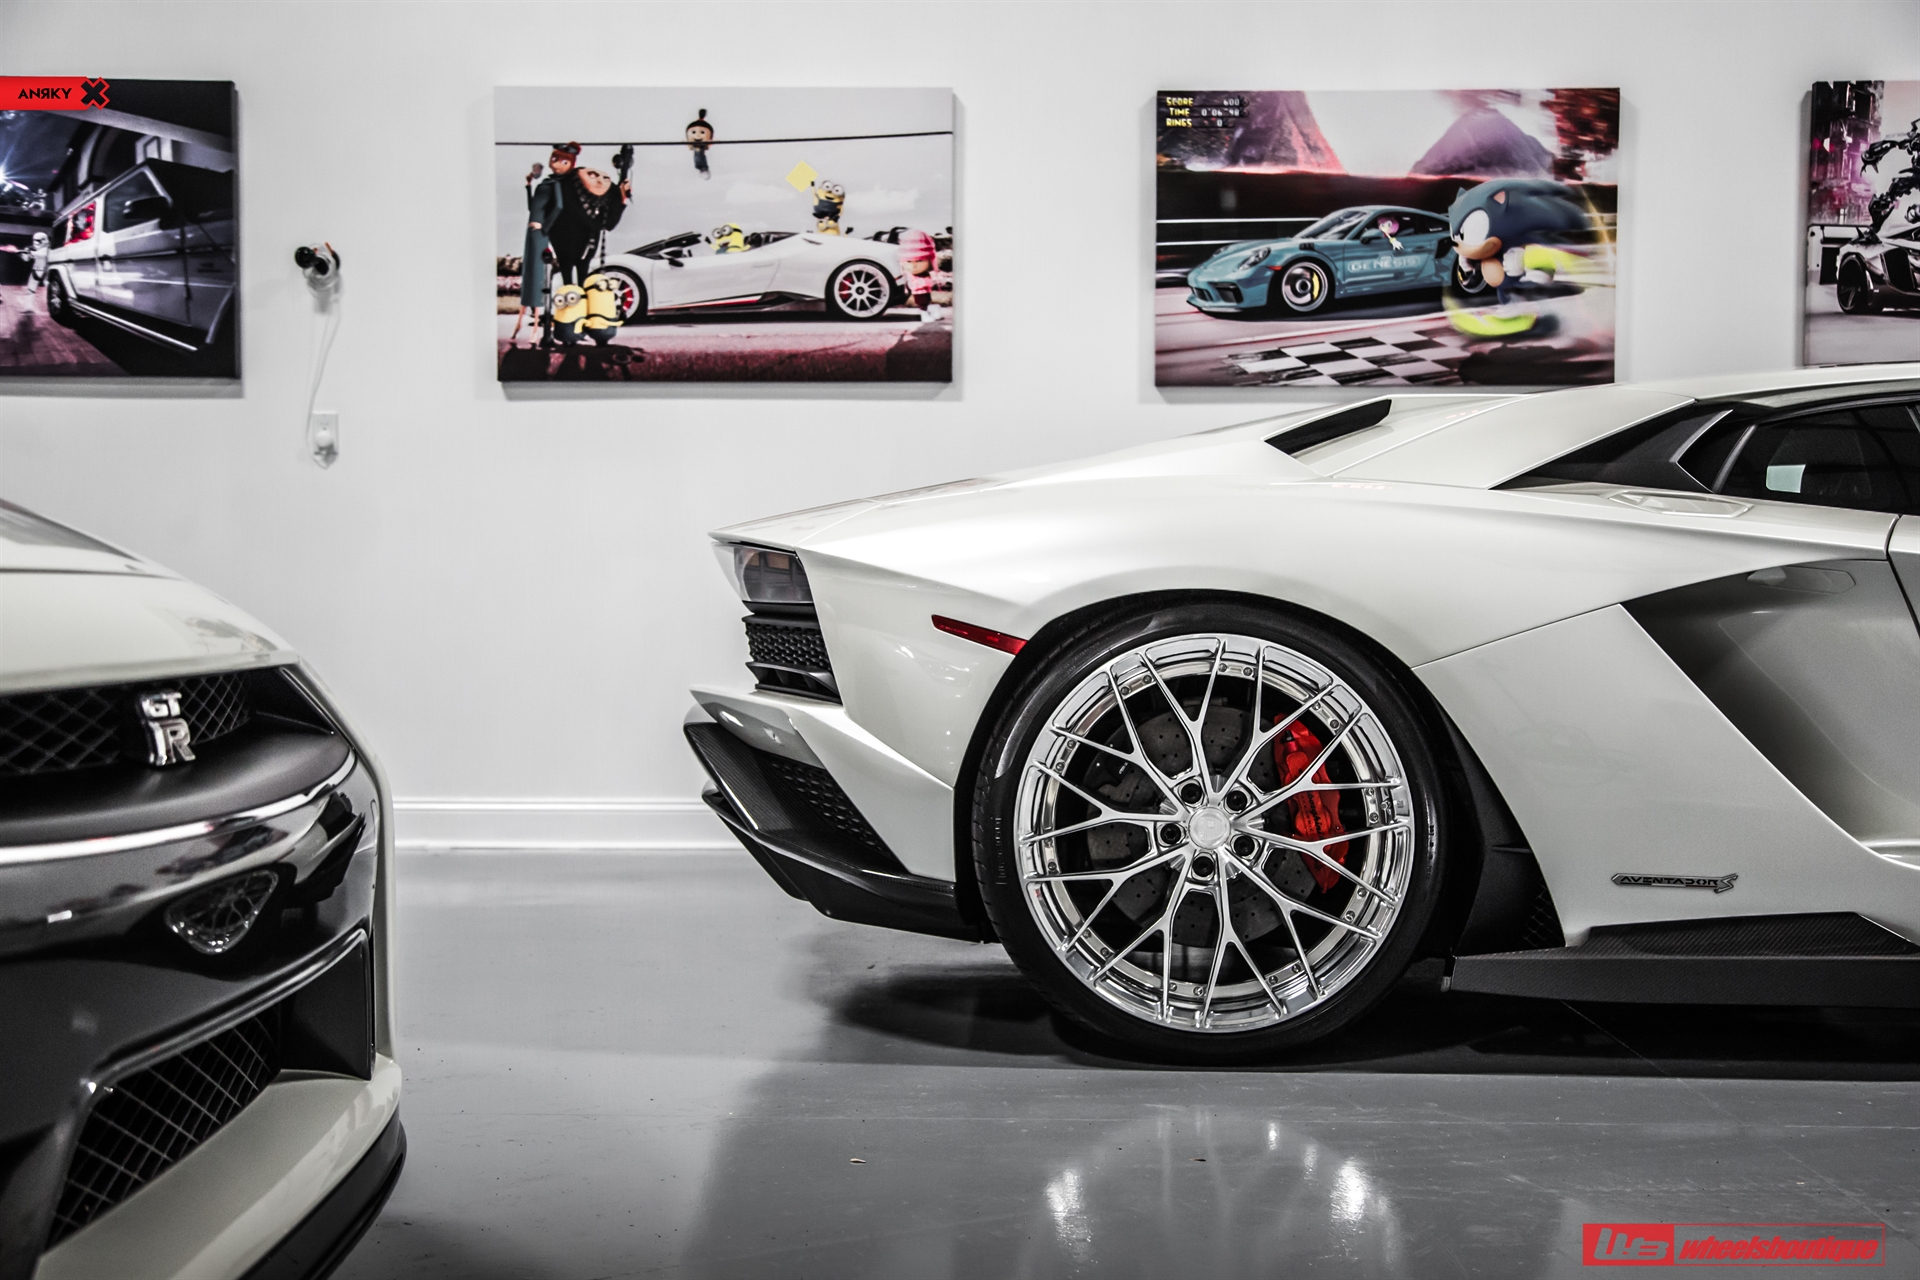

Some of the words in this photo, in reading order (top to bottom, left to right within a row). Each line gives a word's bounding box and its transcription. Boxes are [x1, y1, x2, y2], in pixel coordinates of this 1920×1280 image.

[1166, 97, 1194, 107] SCORE
[1223, 98, 1240, 107] 600
[1169, 107, 1190, 117] TIME
[1166, 117, 1193, 128] RINGS
[1351, 256, 1417, 271] GENESIS
[1620, 875, 1719, 886] AVENTADOR
